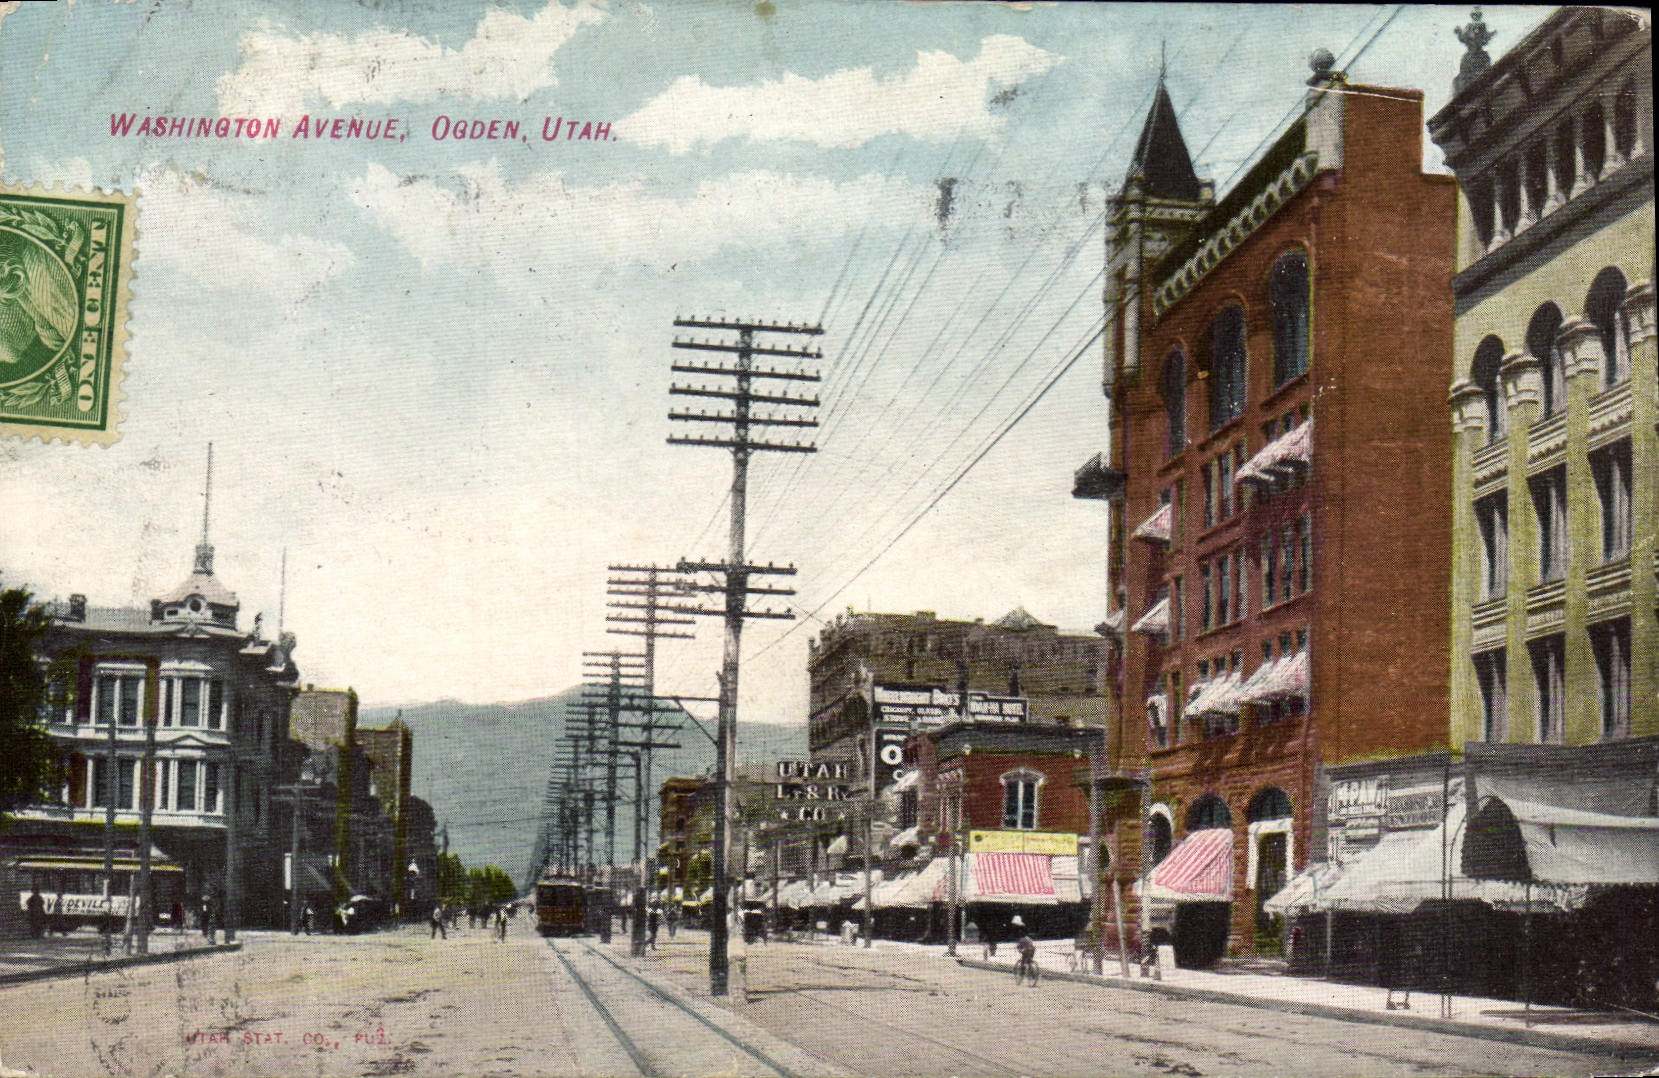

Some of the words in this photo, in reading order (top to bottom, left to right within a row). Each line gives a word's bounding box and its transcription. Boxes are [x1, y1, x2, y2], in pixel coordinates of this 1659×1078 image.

[83, 217, 107, 329] CENT
[77, 328, 101, 413] ONE
[778, 761, 848, 778] UTAH
